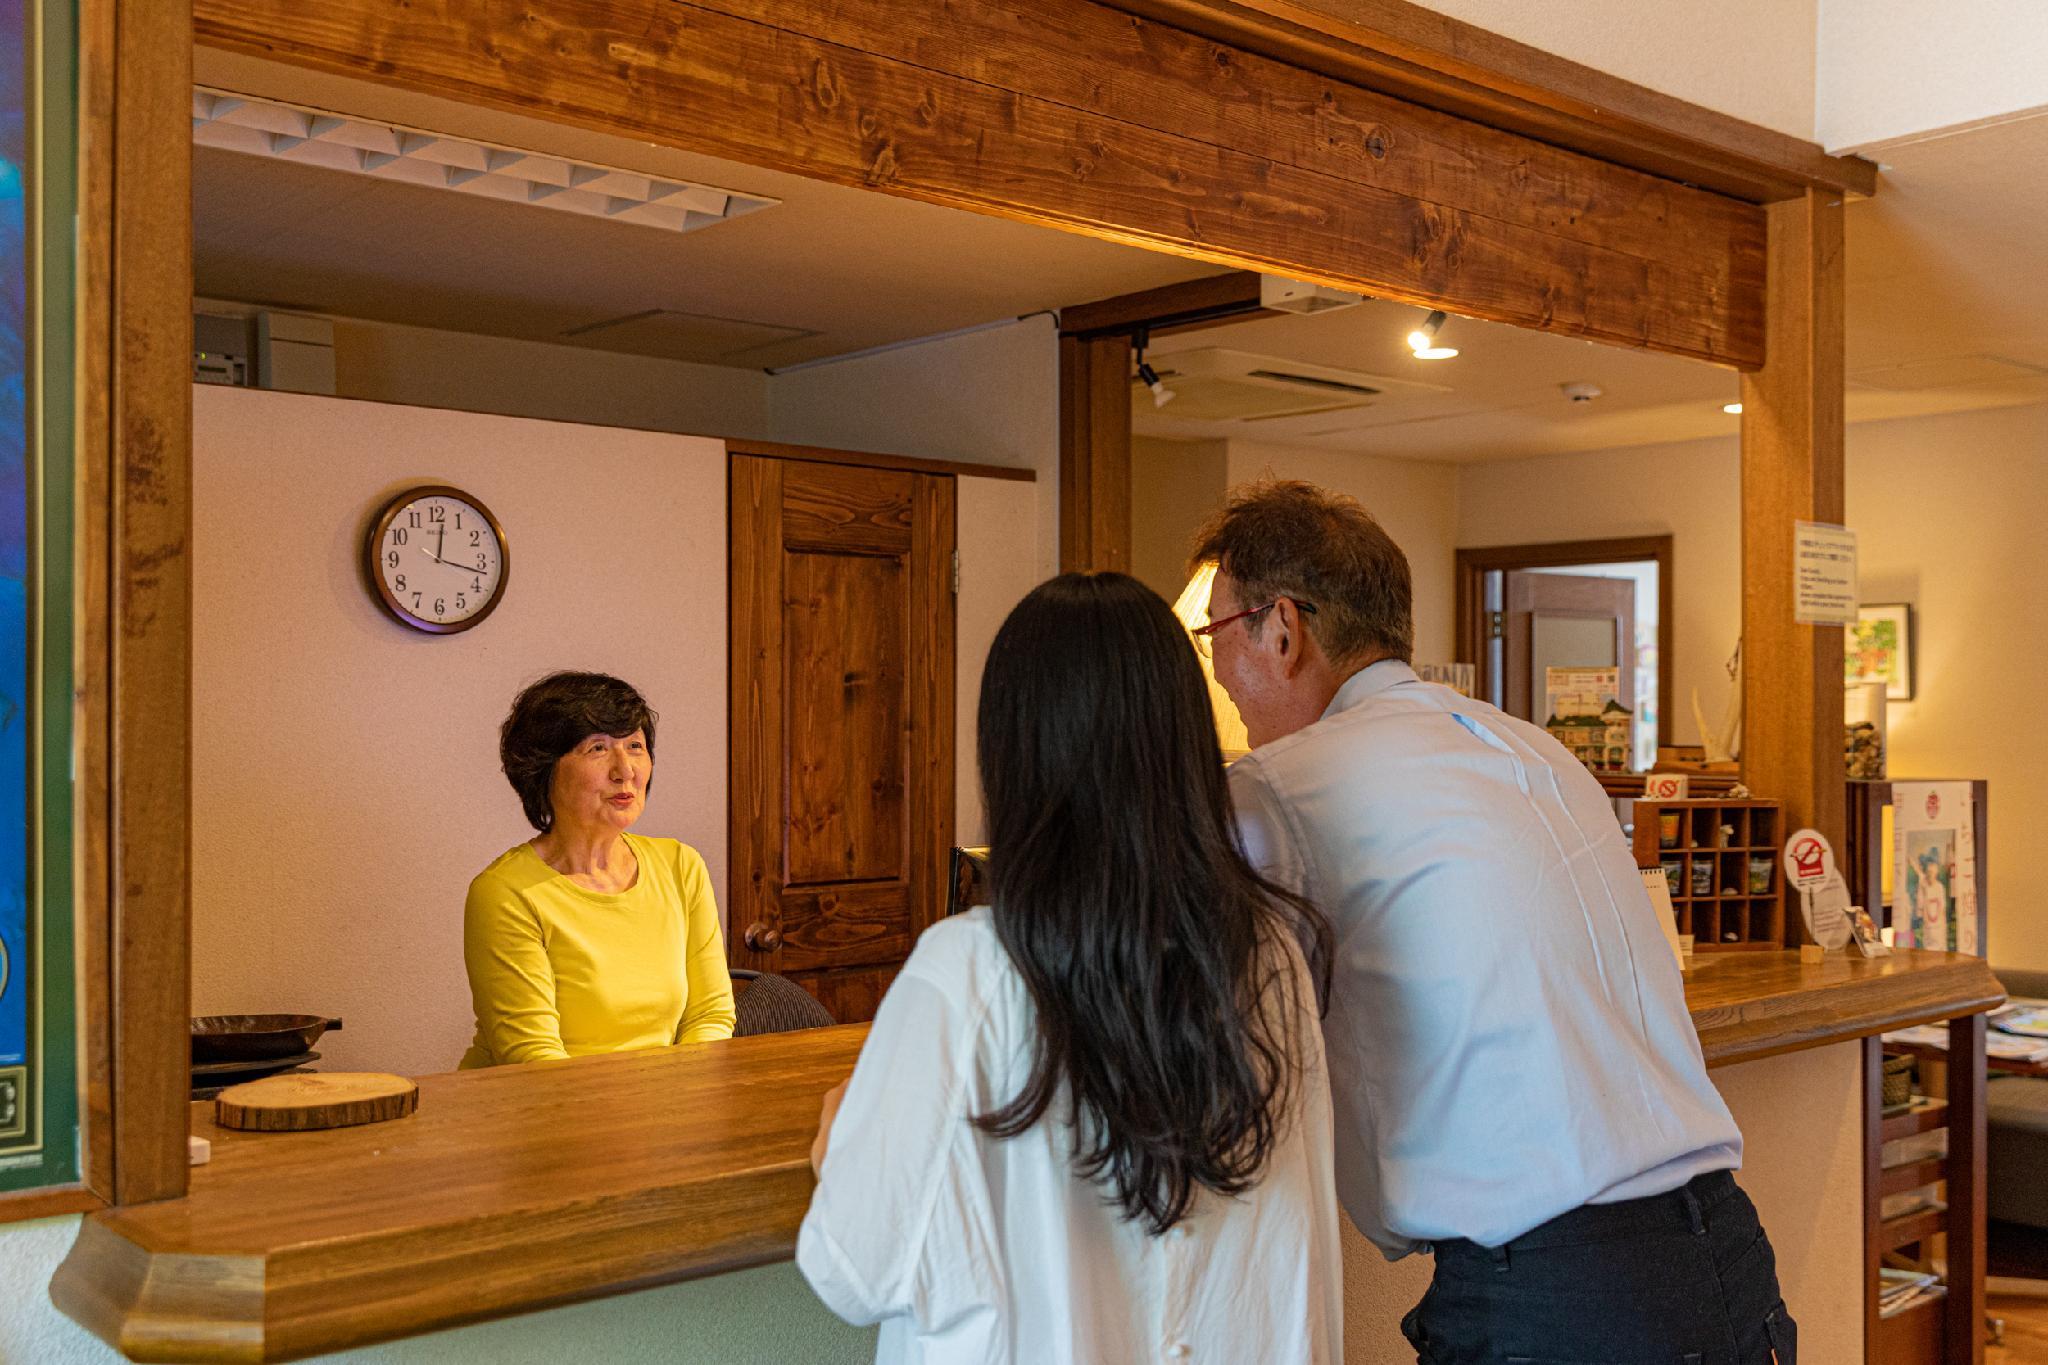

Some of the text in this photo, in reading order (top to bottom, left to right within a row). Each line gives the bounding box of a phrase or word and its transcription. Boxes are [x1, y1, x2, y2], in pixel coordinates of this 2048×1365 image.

[408, 512, 423, 529] 11
[427, 505, 446, 523] 12
[455, 512, 462, 530] 1
[391, 527, 408, 546] 10
[469, 530, 480, 547] 2
[388, 551, 400, 569] 9
[476, 552, 487, 570] 3
[395, 574, 407, 592] 8
[470, 575, 482, 593] 4
[411, 591, 423, 609] 7
[434, 598, 445, 616] 6
[455, 592, 466, 609] 5
